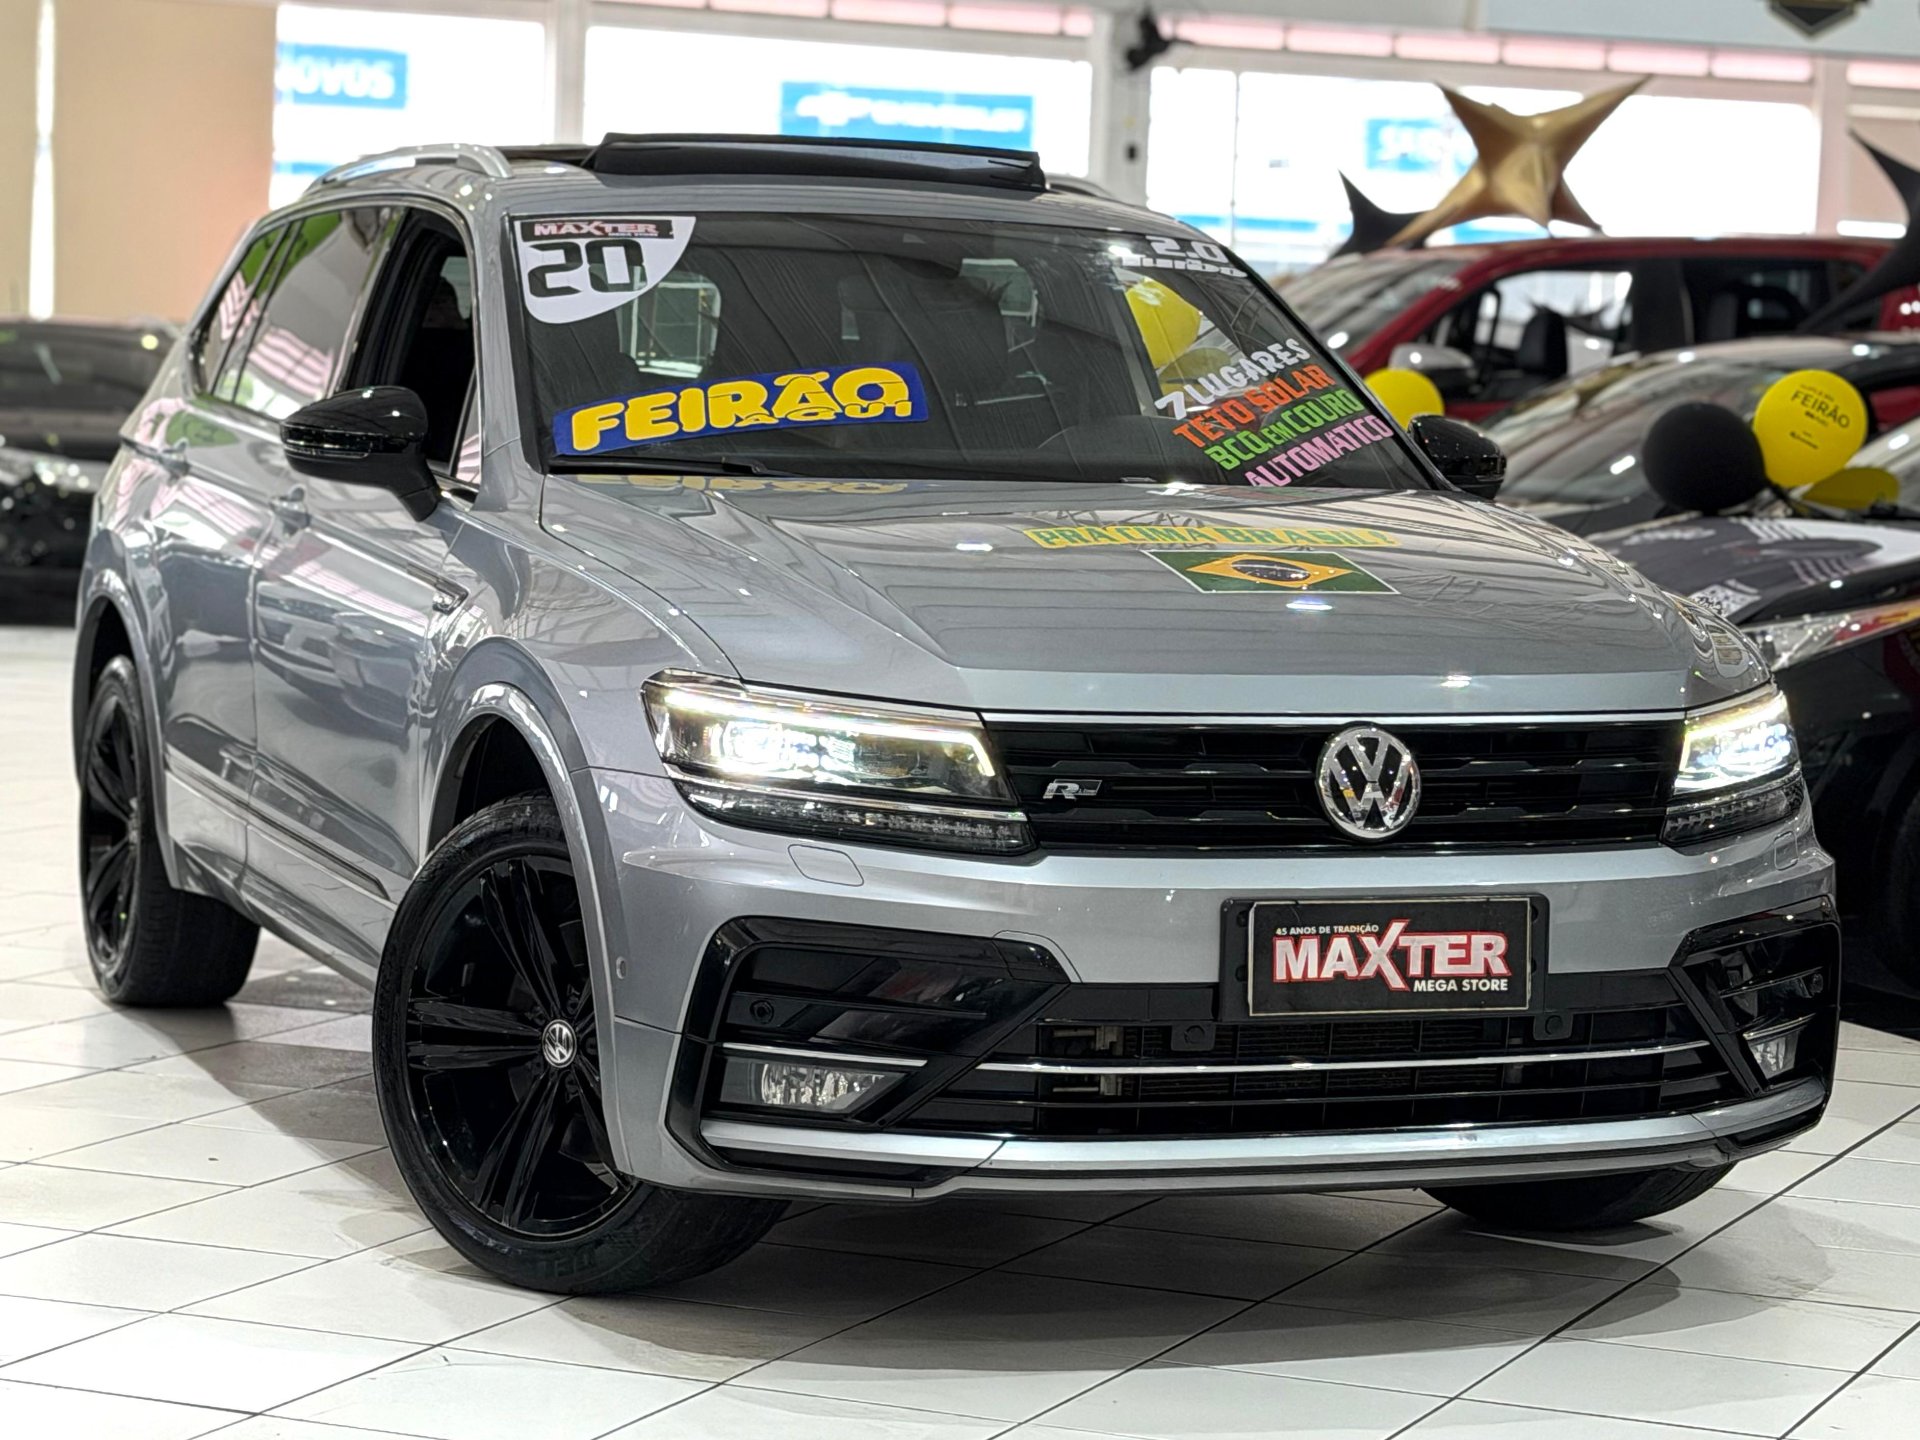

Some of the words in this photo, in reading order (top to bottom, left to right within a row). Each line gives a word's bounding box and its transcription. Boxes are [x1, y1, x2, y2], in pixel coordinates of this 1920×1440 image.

[534, 220, 659, 237] MAXTER
[527, 239, 648, 298] 20
[1145, 235, 1230, 263] 2.0
[1154, 390, 1188, 421] 7
[1184, 338, 1311, 405] LUGARES
[572, 367, 909, 451] FEIRÃO
[734, 400, 913, 428] AQUI
[1172, 399, 1257, 448] TETO
[1243, 363, 1336, 413] SOLAR
[1280, 388, 1365, 433] COURO
[1790, 388, 1850, 428] FEIRÃO
[1031, 527, 1121, 545] PRA
[1114, 527, 1218, 542] CIMA
[1275, 927, 1288, 936] 45
[1289, 926, 1317, 935] ANOS
[1318, 925, 1331, 934] DE
[1333, 922, 1379, 934] TRADIÇÃO
[1273, 919, 1511, 992] MAXTER
[1413, 978, 1458, 993] MEGA
[1462, 978, 1508, 992] STORE
